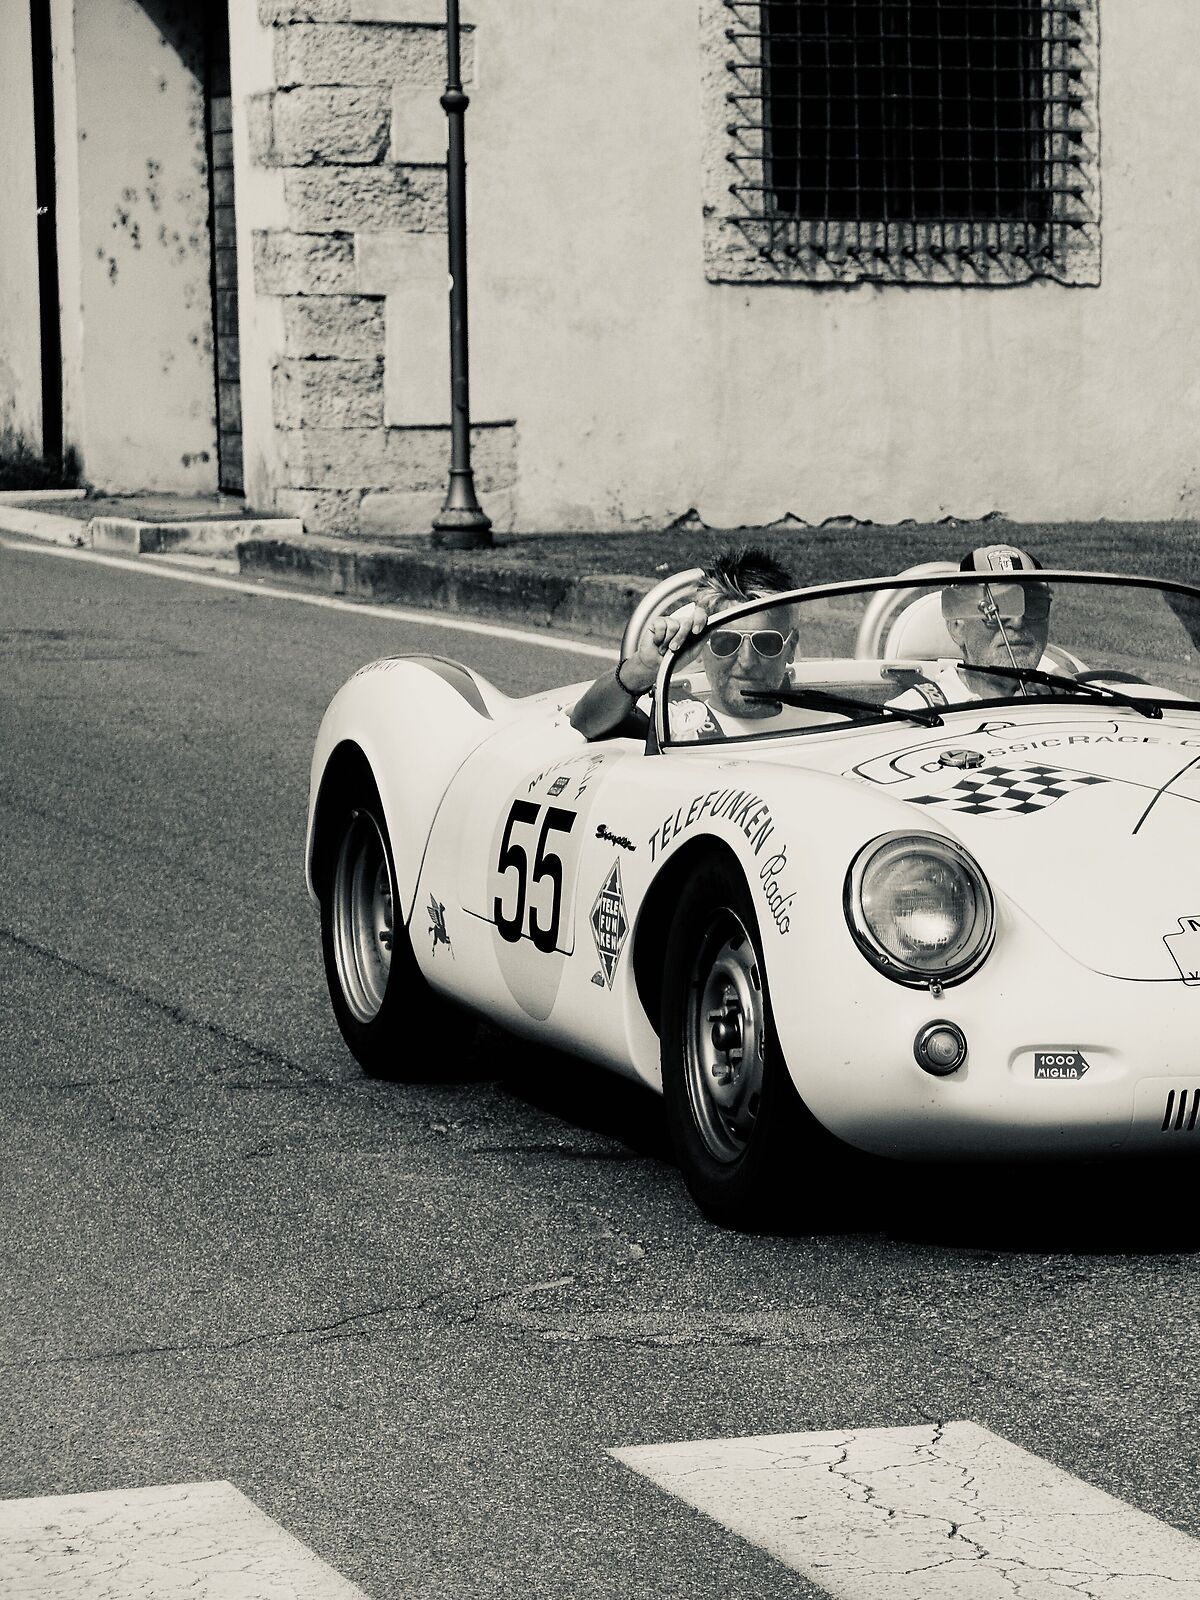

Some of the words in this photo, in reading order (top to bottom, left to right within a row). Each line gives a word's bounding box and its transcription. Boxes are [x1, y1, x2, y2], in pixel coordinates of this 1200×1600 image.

[648, 789, 775, 863] TELEFUNKEN
[760, 844, 797, 935] Radio
[494, 799, 577, 953] 55
[602, 897, 619, 916] TELE
[600, 915, 618, 933] FUN
[600, 931, 617, 950] KEN
[1189, 971, 1199, 980] V
[1040, 1055, 1075, 1065] 1000
[1036, 1067, 1078, 1078] MIGLIA
